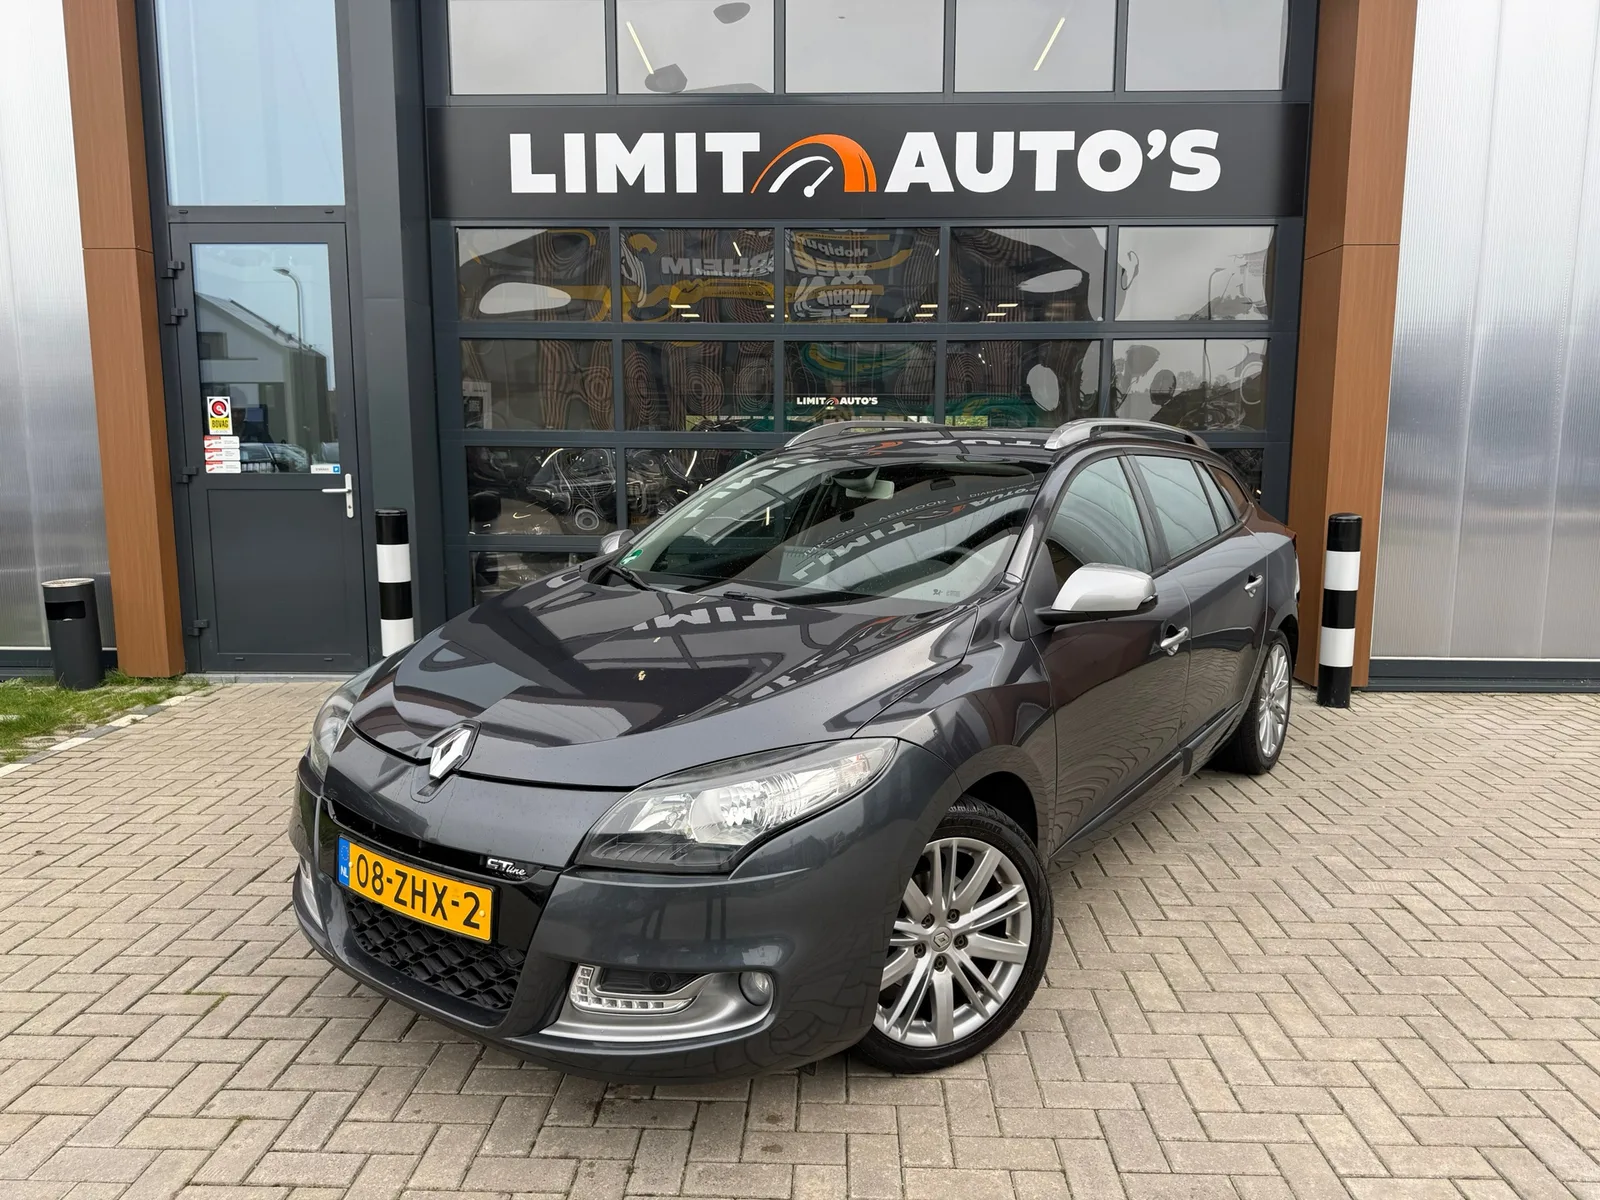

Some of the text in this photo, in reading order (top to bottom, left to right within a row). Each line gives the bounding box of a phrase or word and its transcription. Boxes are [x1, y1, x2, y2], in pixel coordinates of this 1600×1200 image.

[509, 129, 1221, 194] LIMIT AUTO'S
[796, 396, 878, 405] LIMIT AUTO'S
[211, 419, 229, 428] BOVAG
[340, 866, 349, 878] NL
[356, 853, 481, 930] 08-ZHX-2
